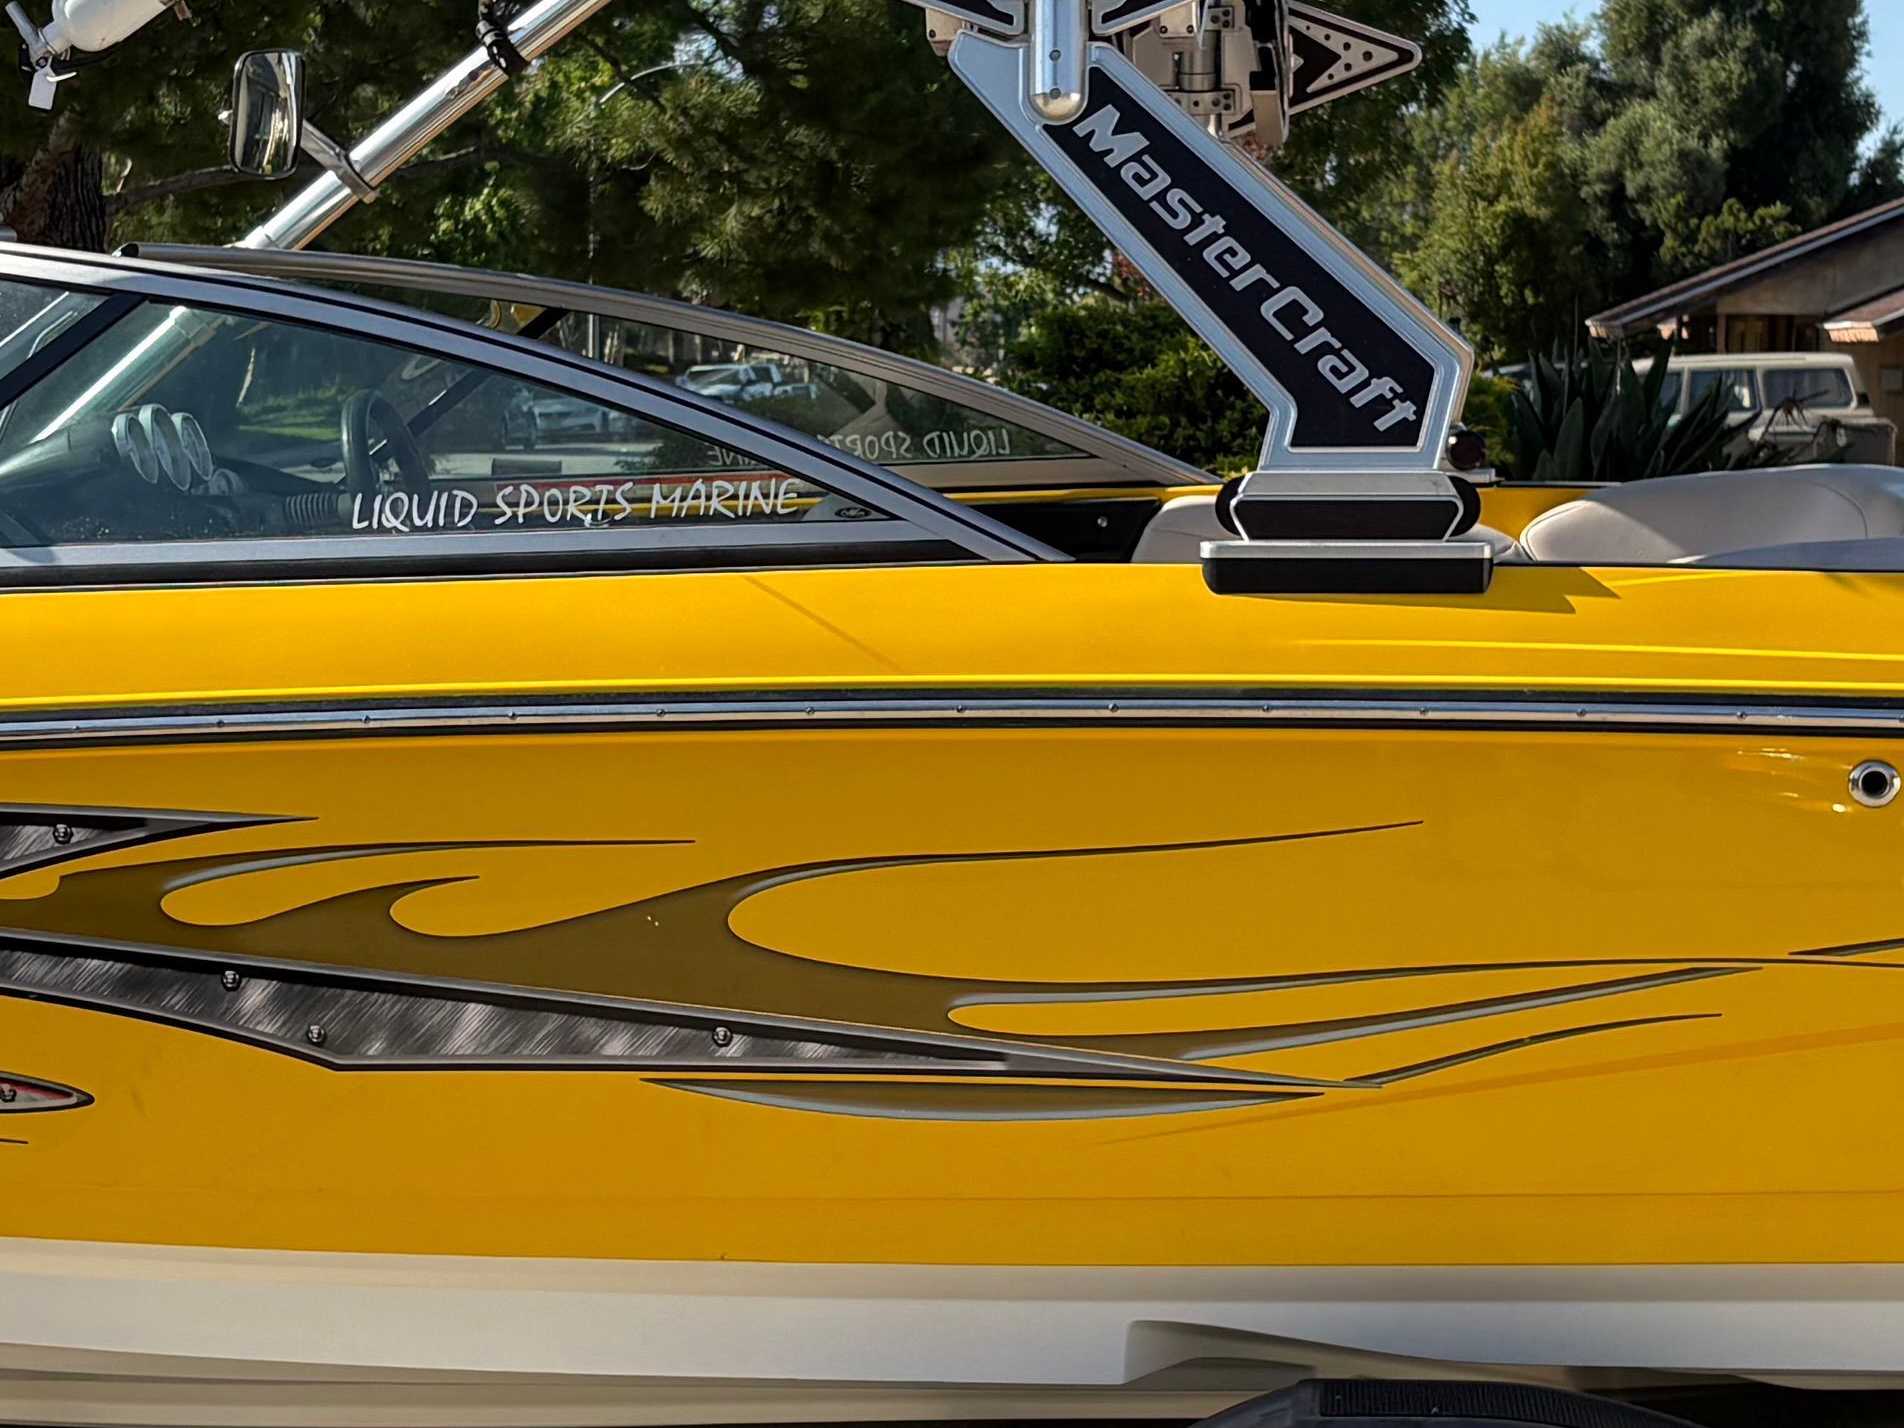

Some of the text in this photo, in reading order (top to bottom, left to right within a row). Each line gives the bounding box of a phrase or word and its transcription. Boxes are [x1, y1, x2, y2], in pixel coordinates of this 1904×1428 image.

[1072, 104, 1416, 433] MasterCraft
[351, 477, 799, 532] LIQUID SPORTS MARINE
